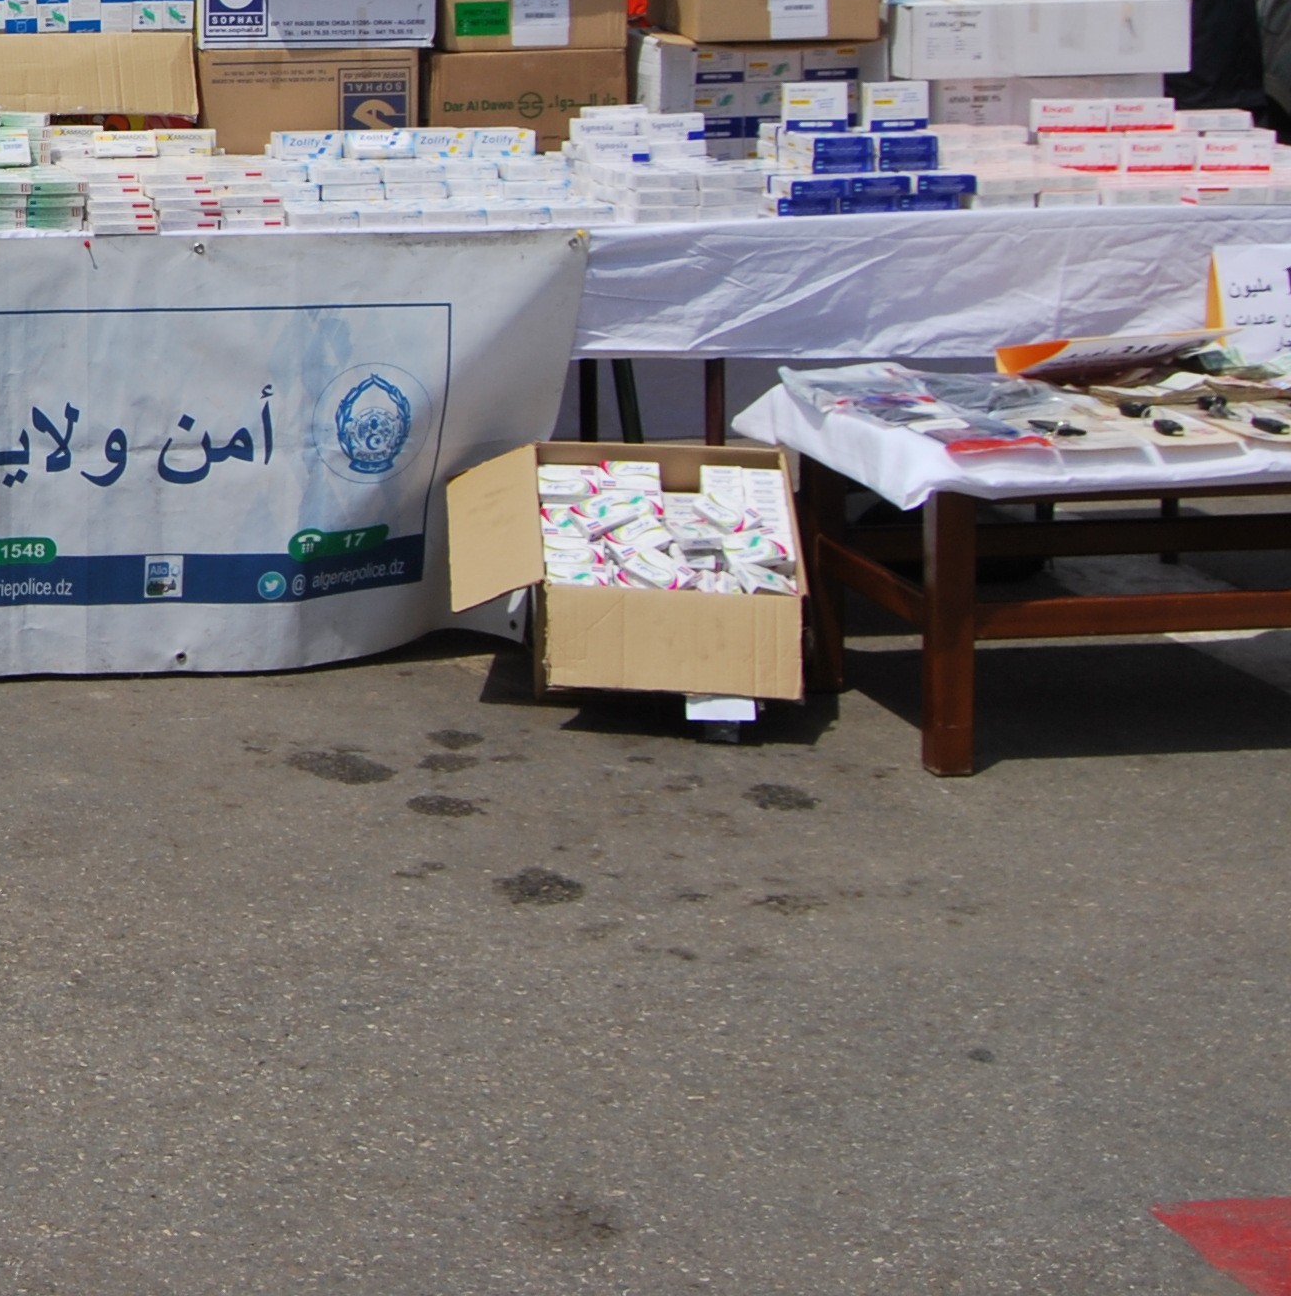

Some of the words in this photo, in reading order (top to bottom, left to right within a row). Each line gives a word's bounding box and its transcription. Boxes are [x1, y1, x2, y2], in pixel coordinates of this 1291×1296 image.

[211, 16, 261, 25] SOPHAL
[443, 102, 463, 112] Dar
[1228, 277, 1272, 298] مليون
[157, 384, 275, 485] أمن
[343, 532, 366, 549] 17
[0, 542, 46, 559] 1548
[312, 558, 405, 590] algeriepolice.dz
